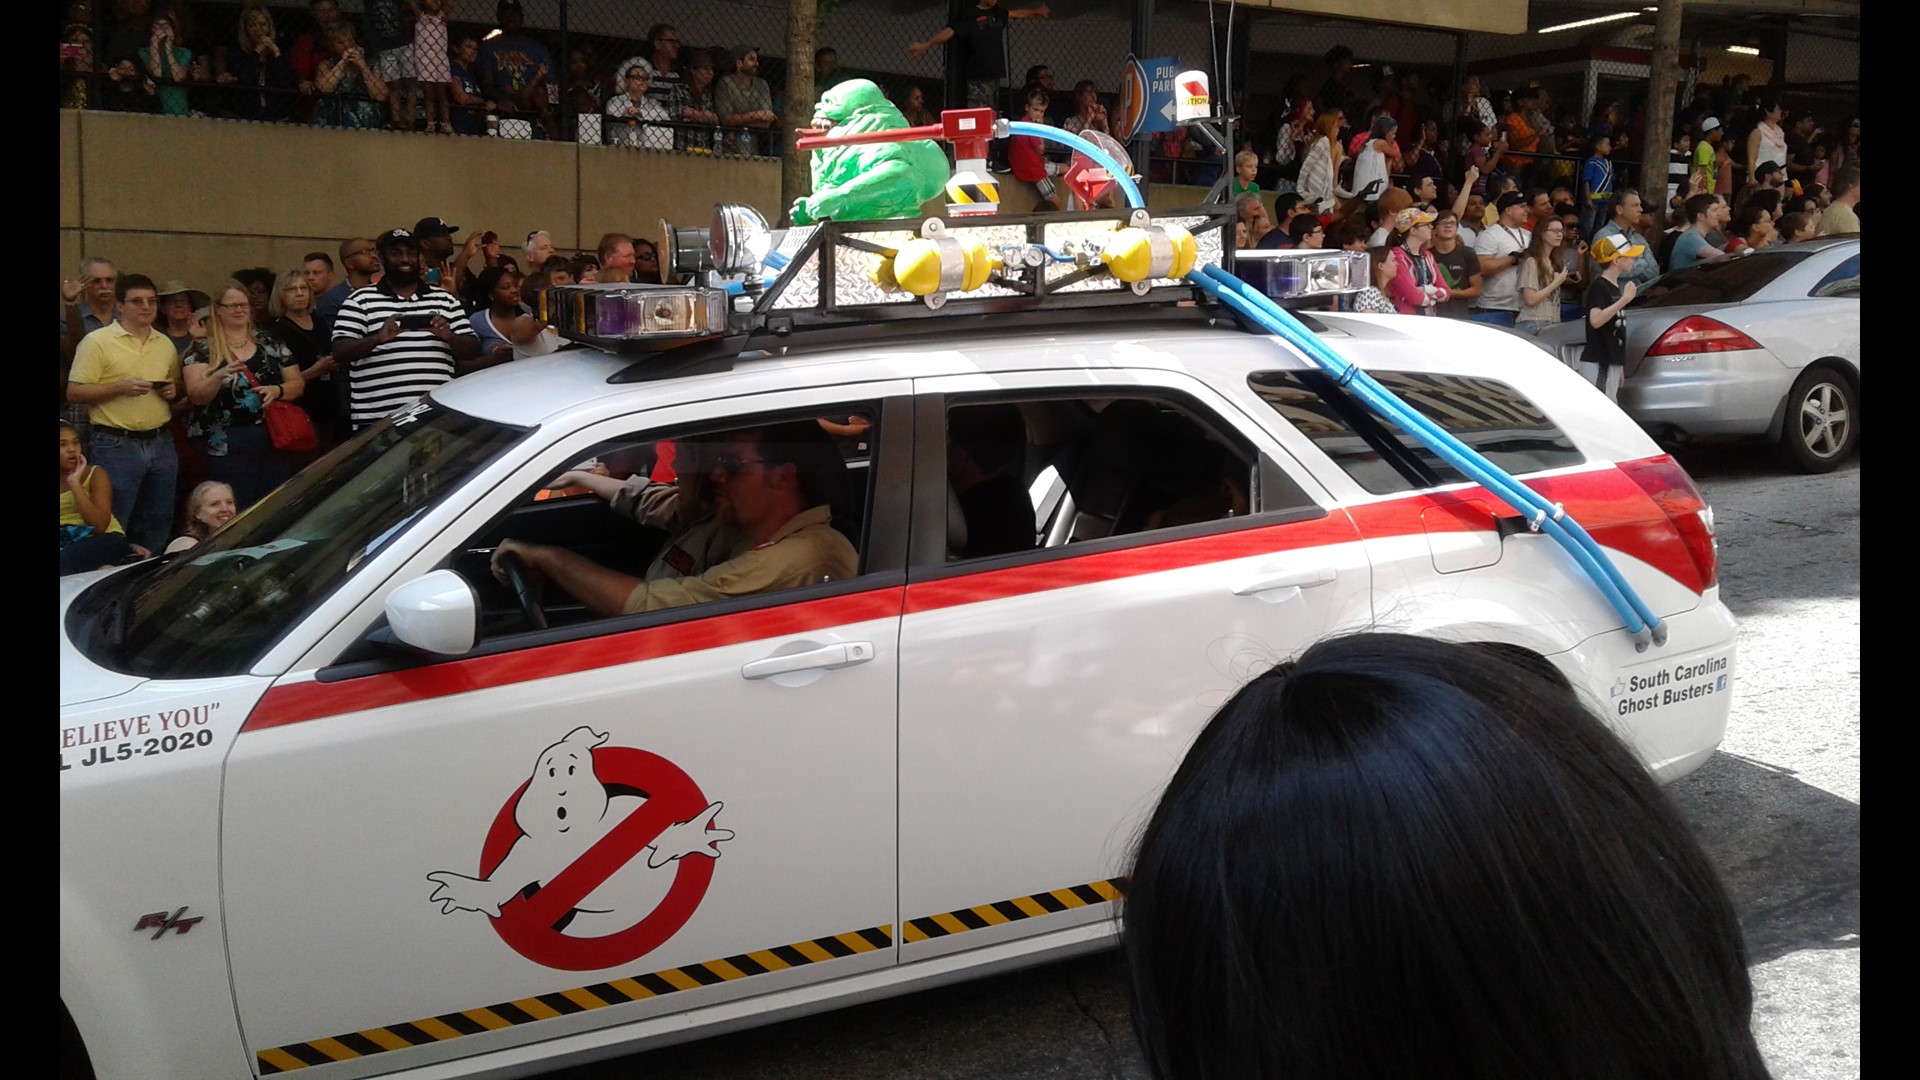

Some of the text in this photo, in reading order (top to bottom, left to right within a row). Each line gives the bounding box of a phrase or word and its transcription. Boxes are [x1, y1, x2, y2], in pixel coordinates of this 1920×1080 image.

[1629, 657, 1727, 692] South Carolina
[1618, 693, 1659, 716] Ghost
[1663, 681, 1714, 706] Busters
[62, 715, 150, 748] ELIEVE
[81, 729, 213, 767] JL5-2020
[133, 905, 204, 940] R/T
